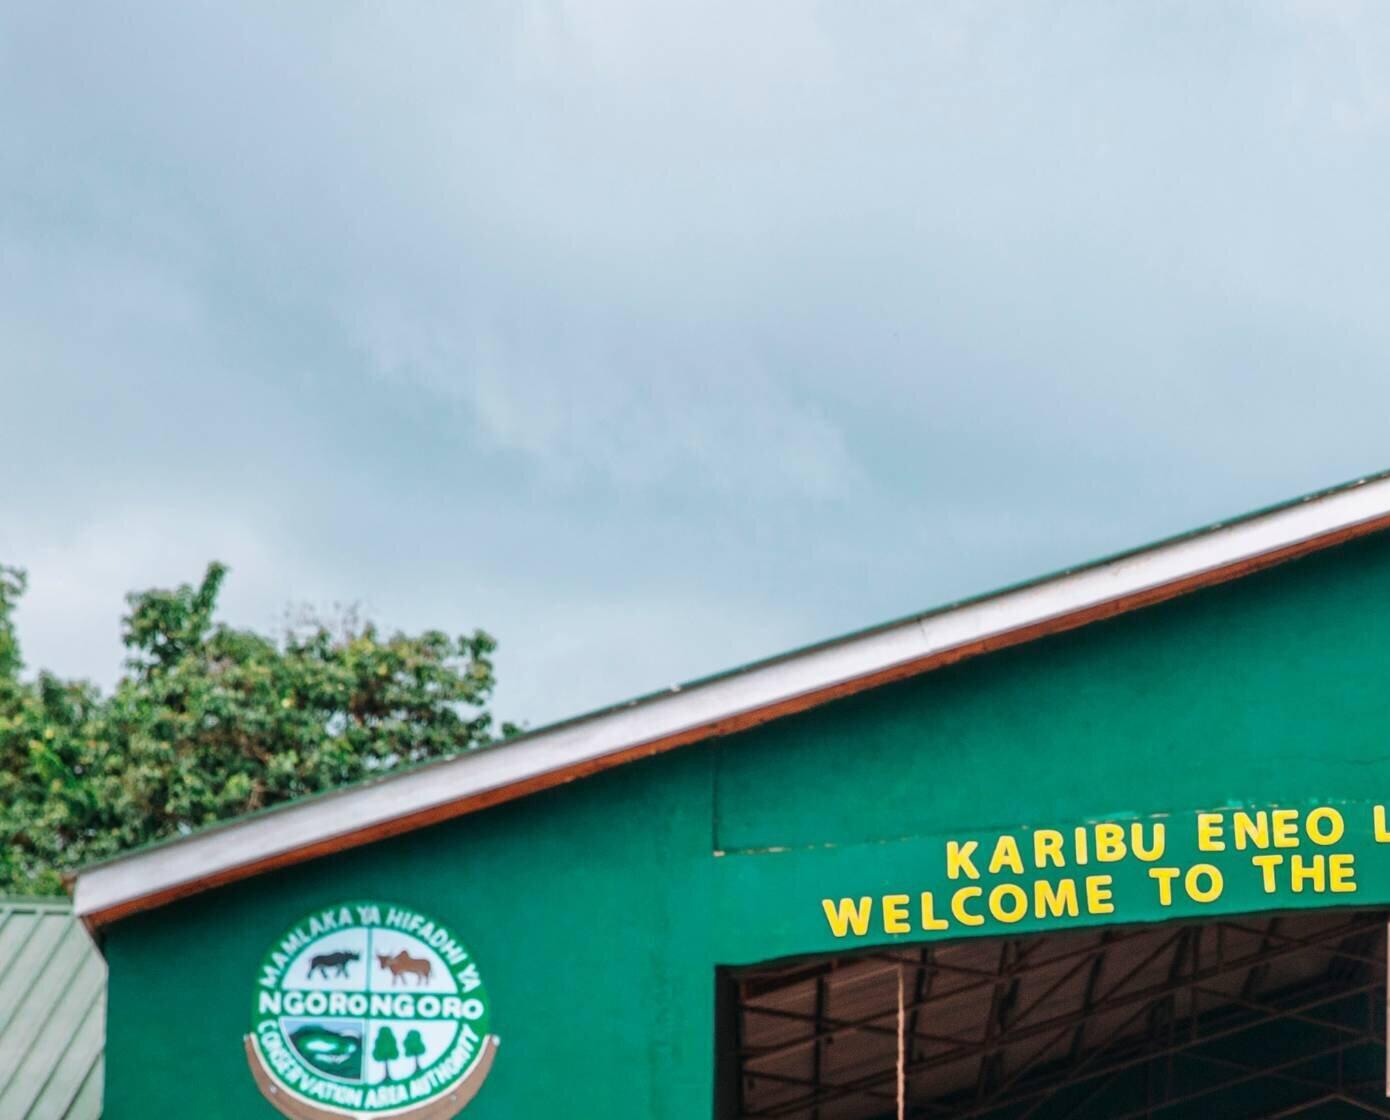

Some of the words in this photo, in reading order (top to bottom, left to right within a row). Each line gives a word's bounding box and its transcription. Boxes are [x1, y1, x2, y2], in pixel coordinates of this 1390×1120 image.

[948, 824, 1165, 879] KARIBU
[1198, 808, 1344, 852] ENEO
[356, 905, 381, 926] YA
[823, 875, 1114, 937] WELCOME
[1149, 864, 1224, 905] TO
[1253, 854, 1357, 893] THE
[258, 990, 485, 1020] NGORONGORO
